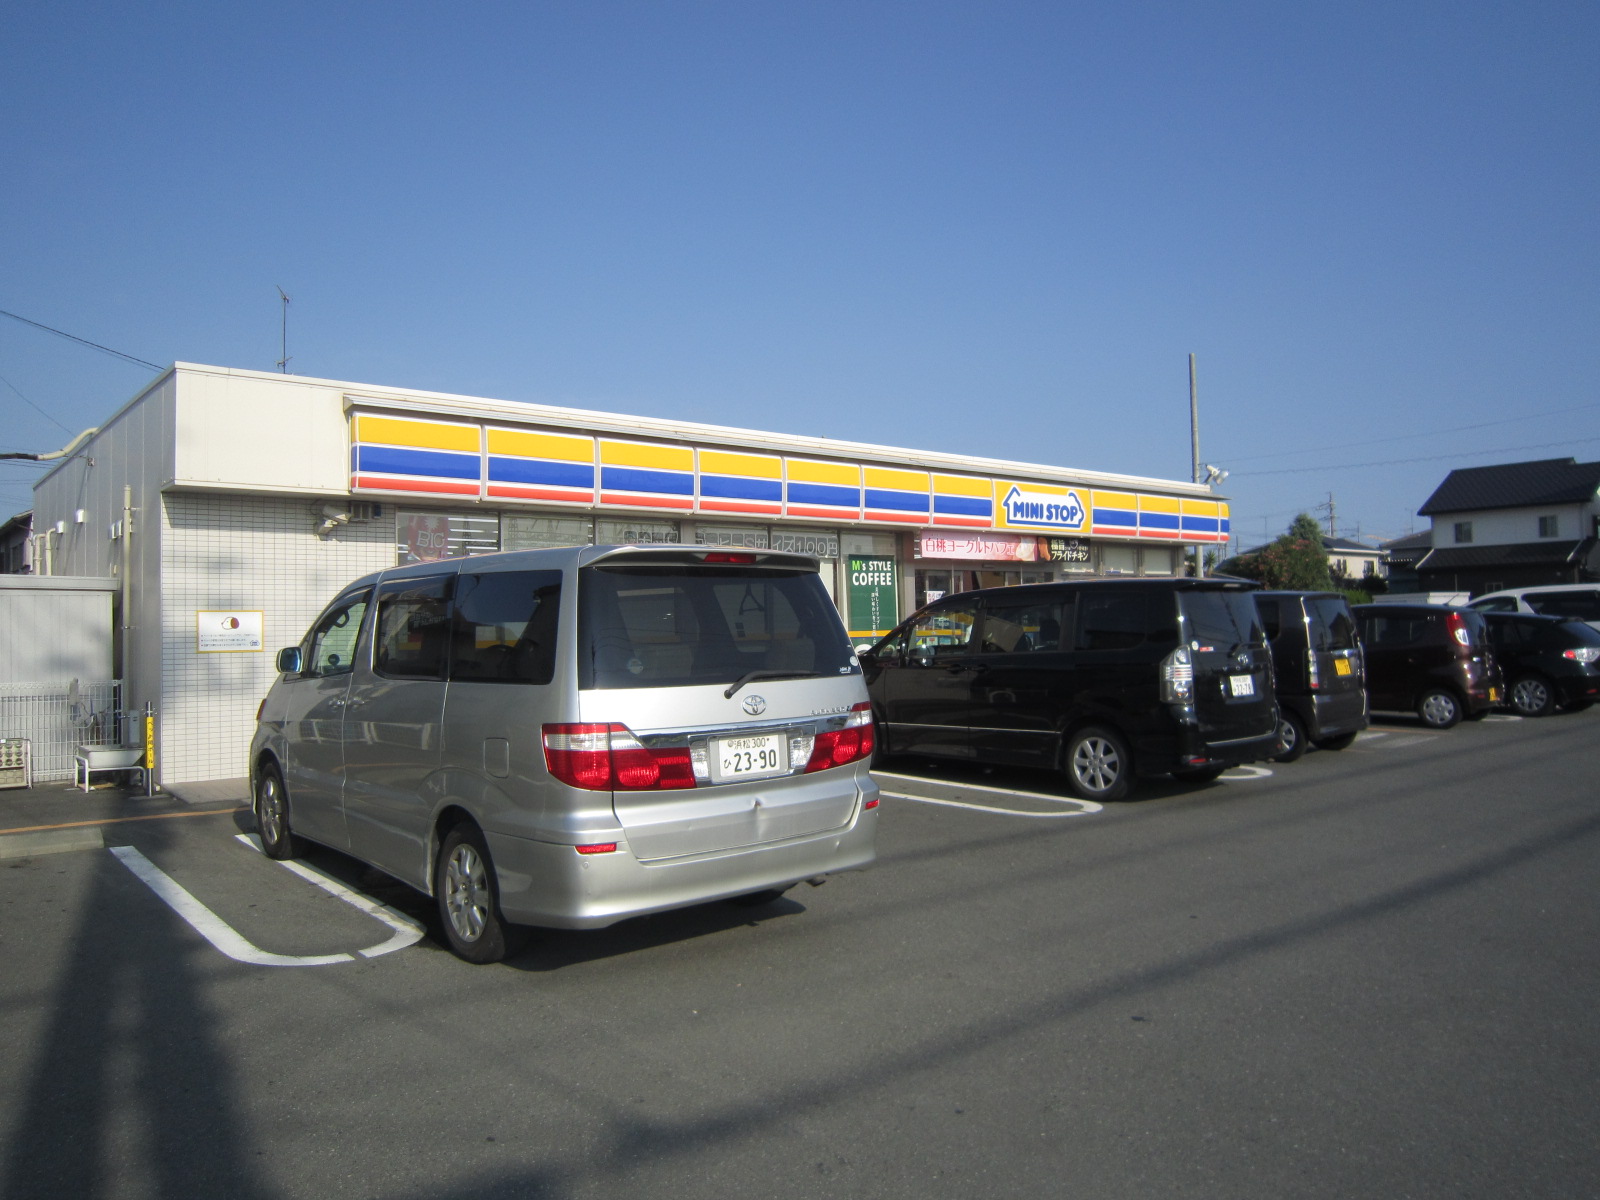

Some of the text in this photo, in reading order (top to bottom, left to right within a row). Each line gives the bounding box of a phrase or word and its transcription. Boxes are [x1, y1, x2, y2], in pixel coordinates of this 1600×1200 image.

[1013, 501, 1078, 522] MINI STOP
[416, 530, 445, 548] BIG
[1051, 550, 1089, 562] フライドチキン
[852, 560, 892, 571] M's STYLE
[852, 572, 892, 586] COFFEE
[723, 749, 777, 773] ひ 23-90
